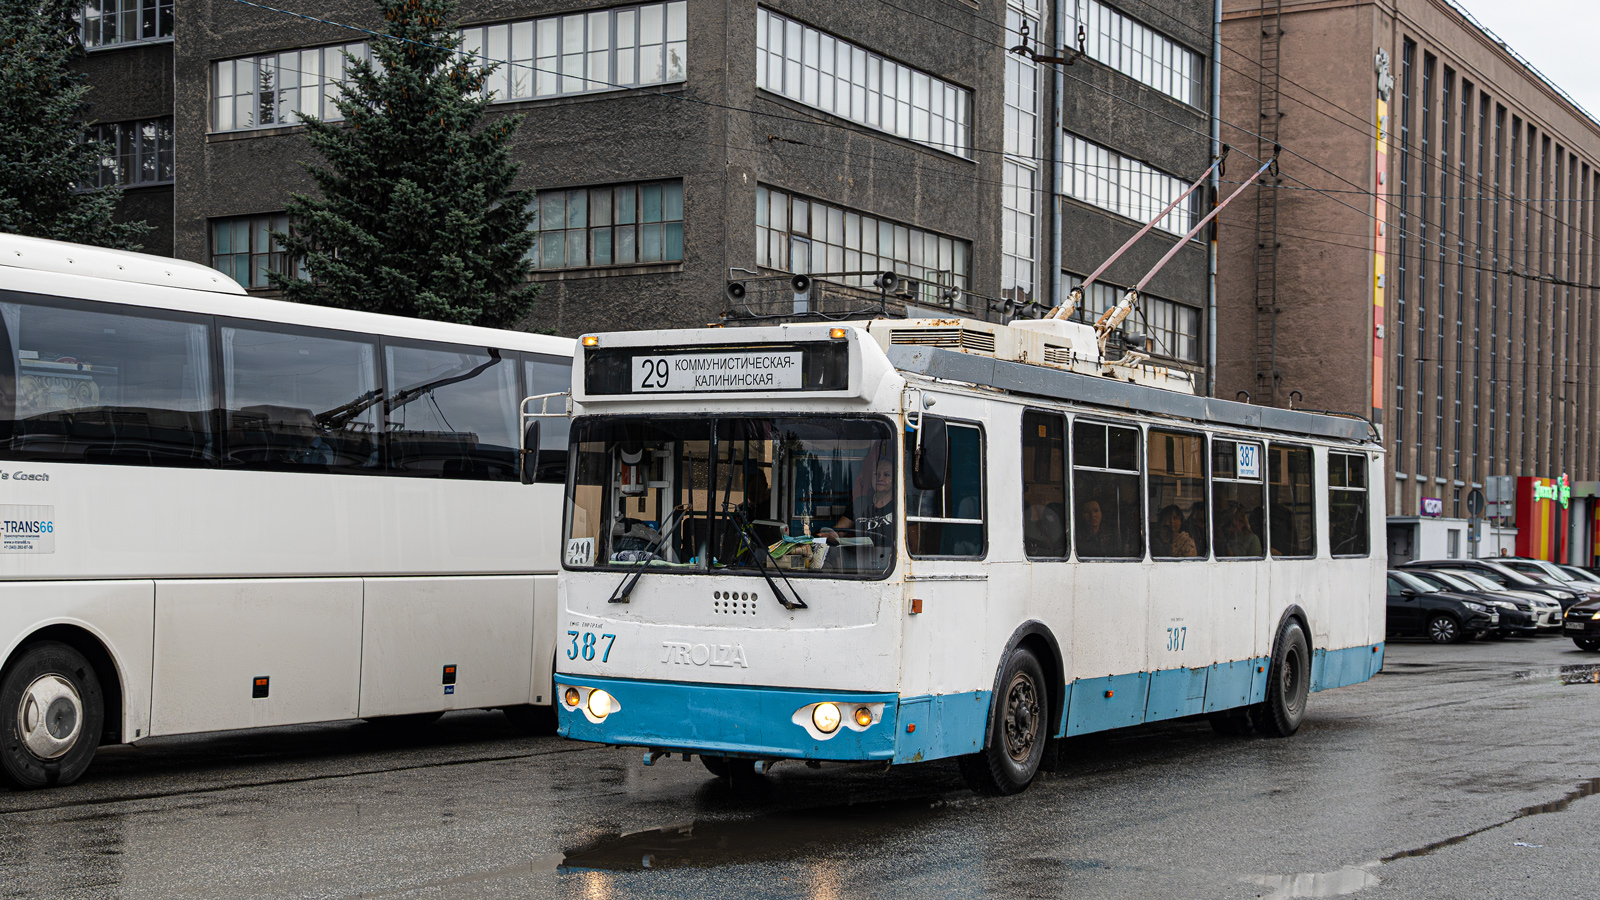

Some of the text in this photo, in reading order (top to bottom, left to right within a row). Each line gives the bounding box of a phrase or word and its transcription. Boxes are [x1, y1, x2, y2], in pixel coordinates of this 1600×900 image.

[641, 358, 670, 389] 29
[674, 356, 795, 371] КОММУНИСТИЧЕСКАЯ-
[695, 373, 774, 387] КАЛИНИНСКАЯ
[1239, 445, 1255, 467] 387
[12, 471, 50, 481] Coach
[0, 521, 54, 533] -TRANS66
[569, 541, 591, 564] 29
[566, 630, 616, 663] 387
[1167, 626, 1187, 652] 387
[661, 641, 749, 668] TROLZA
